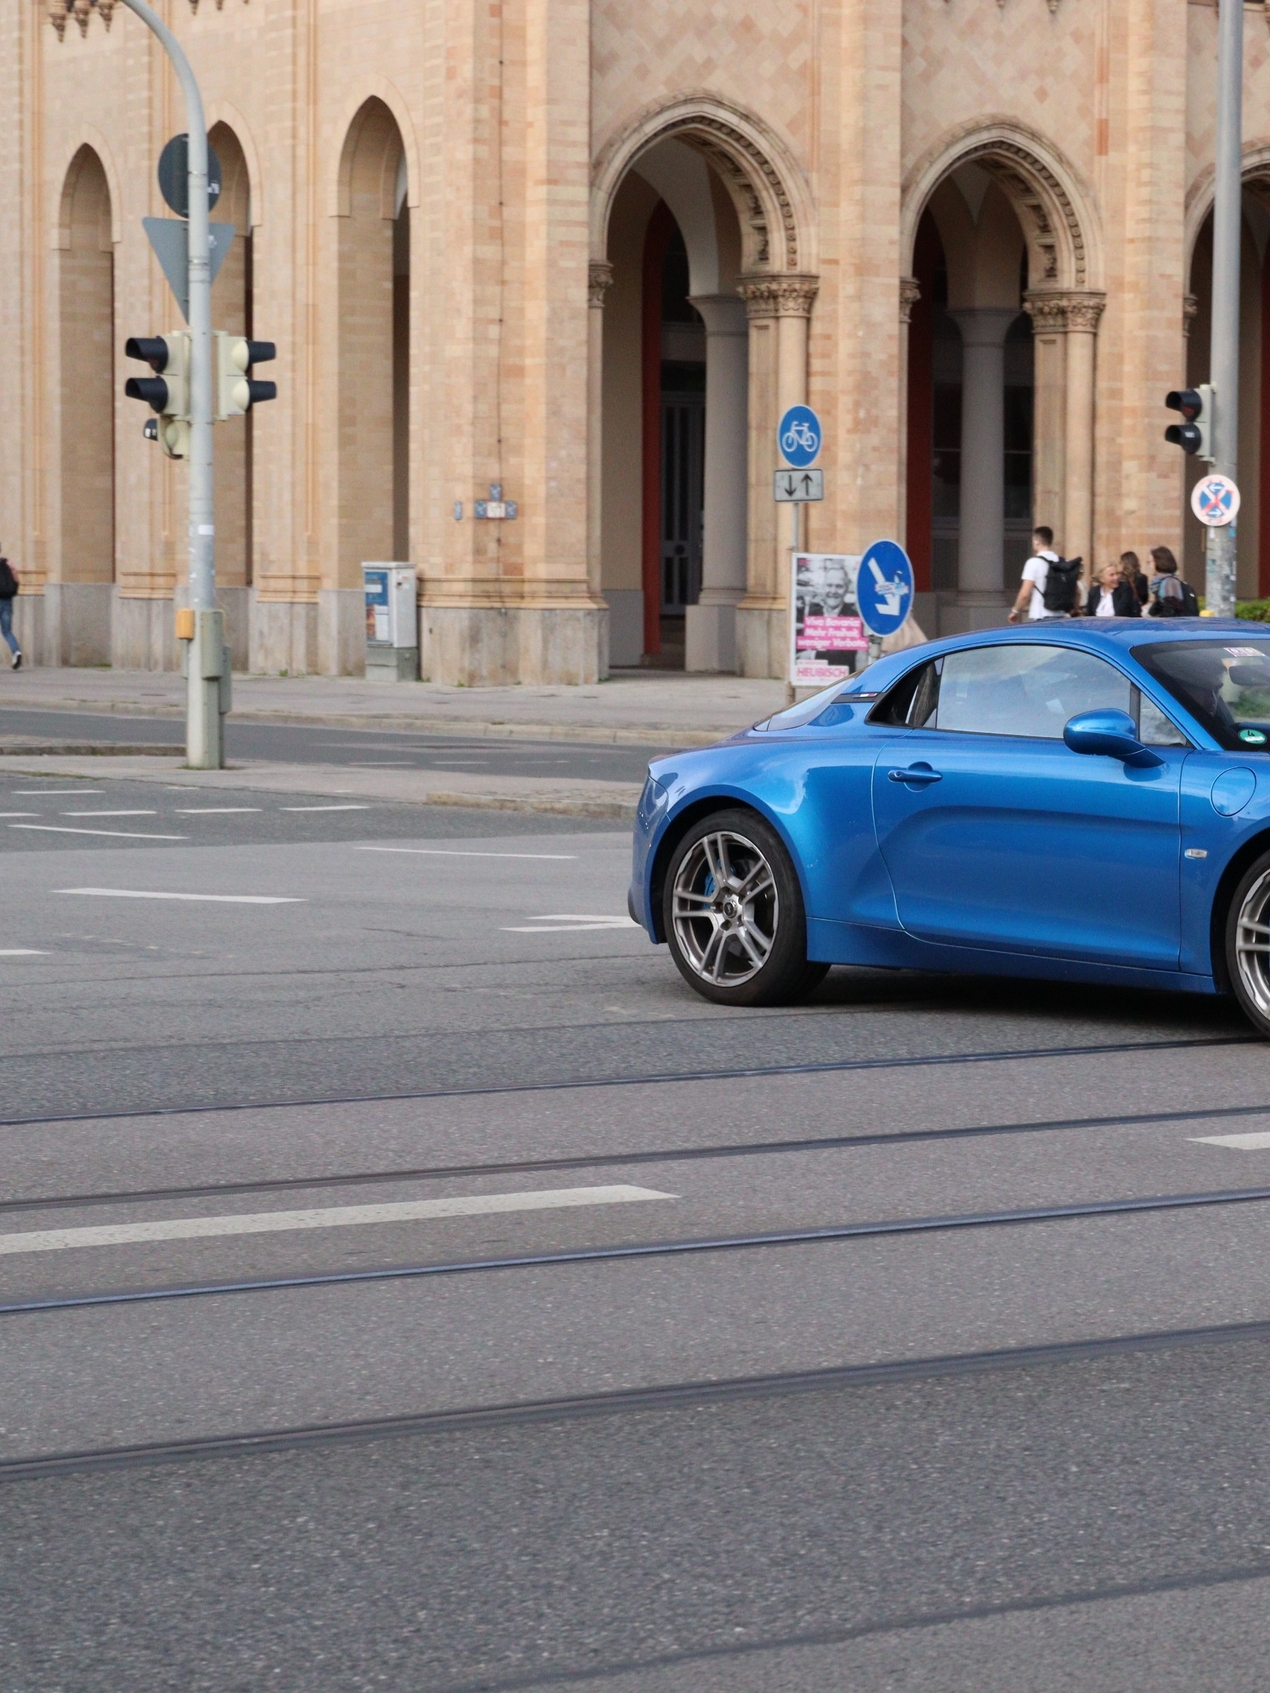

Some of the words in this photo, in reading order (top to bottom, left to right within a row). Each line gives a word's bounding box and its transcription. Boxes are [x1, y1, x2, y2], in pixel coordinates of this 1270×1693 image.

[805, 617, 824, 626] Viva
[804, 627, 826, 636] Mehr
[797, 637, 831, 649] weniger
[797, 667, 846, 677] HEUBISCH
